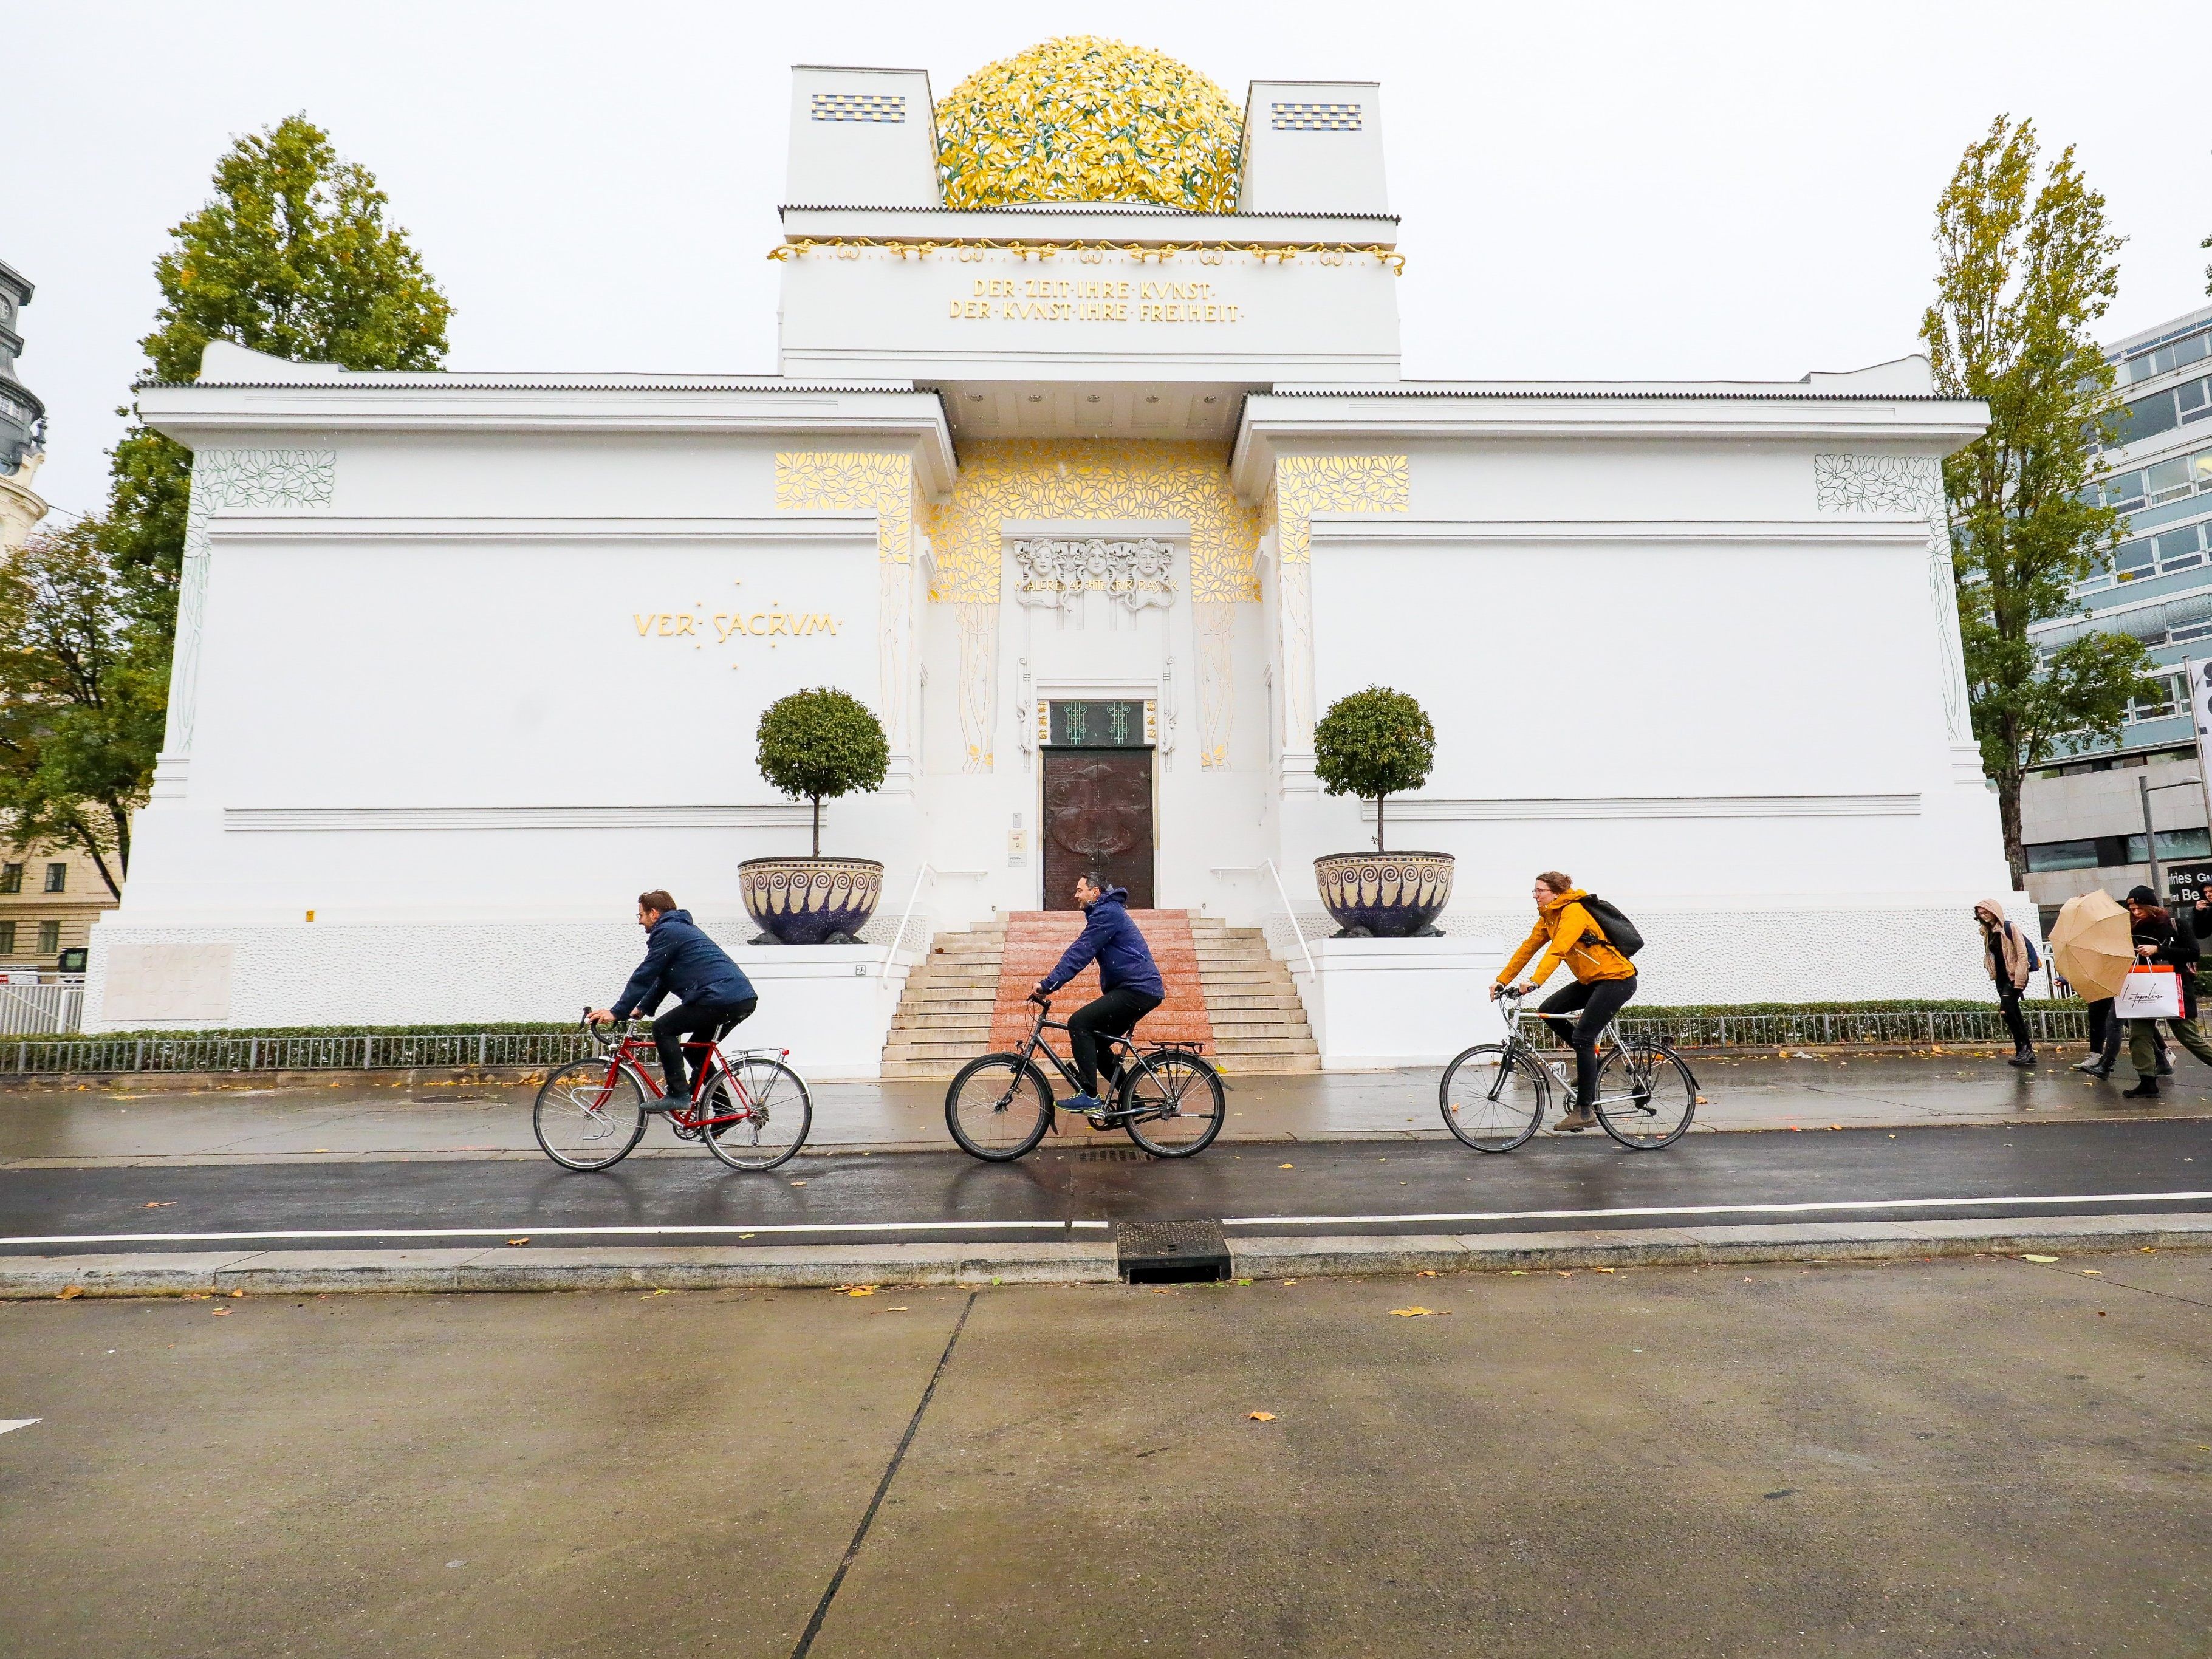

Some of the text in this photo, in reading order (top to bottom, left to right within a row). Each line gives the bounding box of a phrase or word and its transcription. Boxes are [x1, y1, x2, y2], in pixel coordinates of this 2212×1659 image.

[973, 279, 1210, 300] DER ZEIT IHRE KVNST
[950, 301, 1238, 323] DER KVNST IHRE FREIHEIT
[633, 612, 837, 644] VER SACRVM
